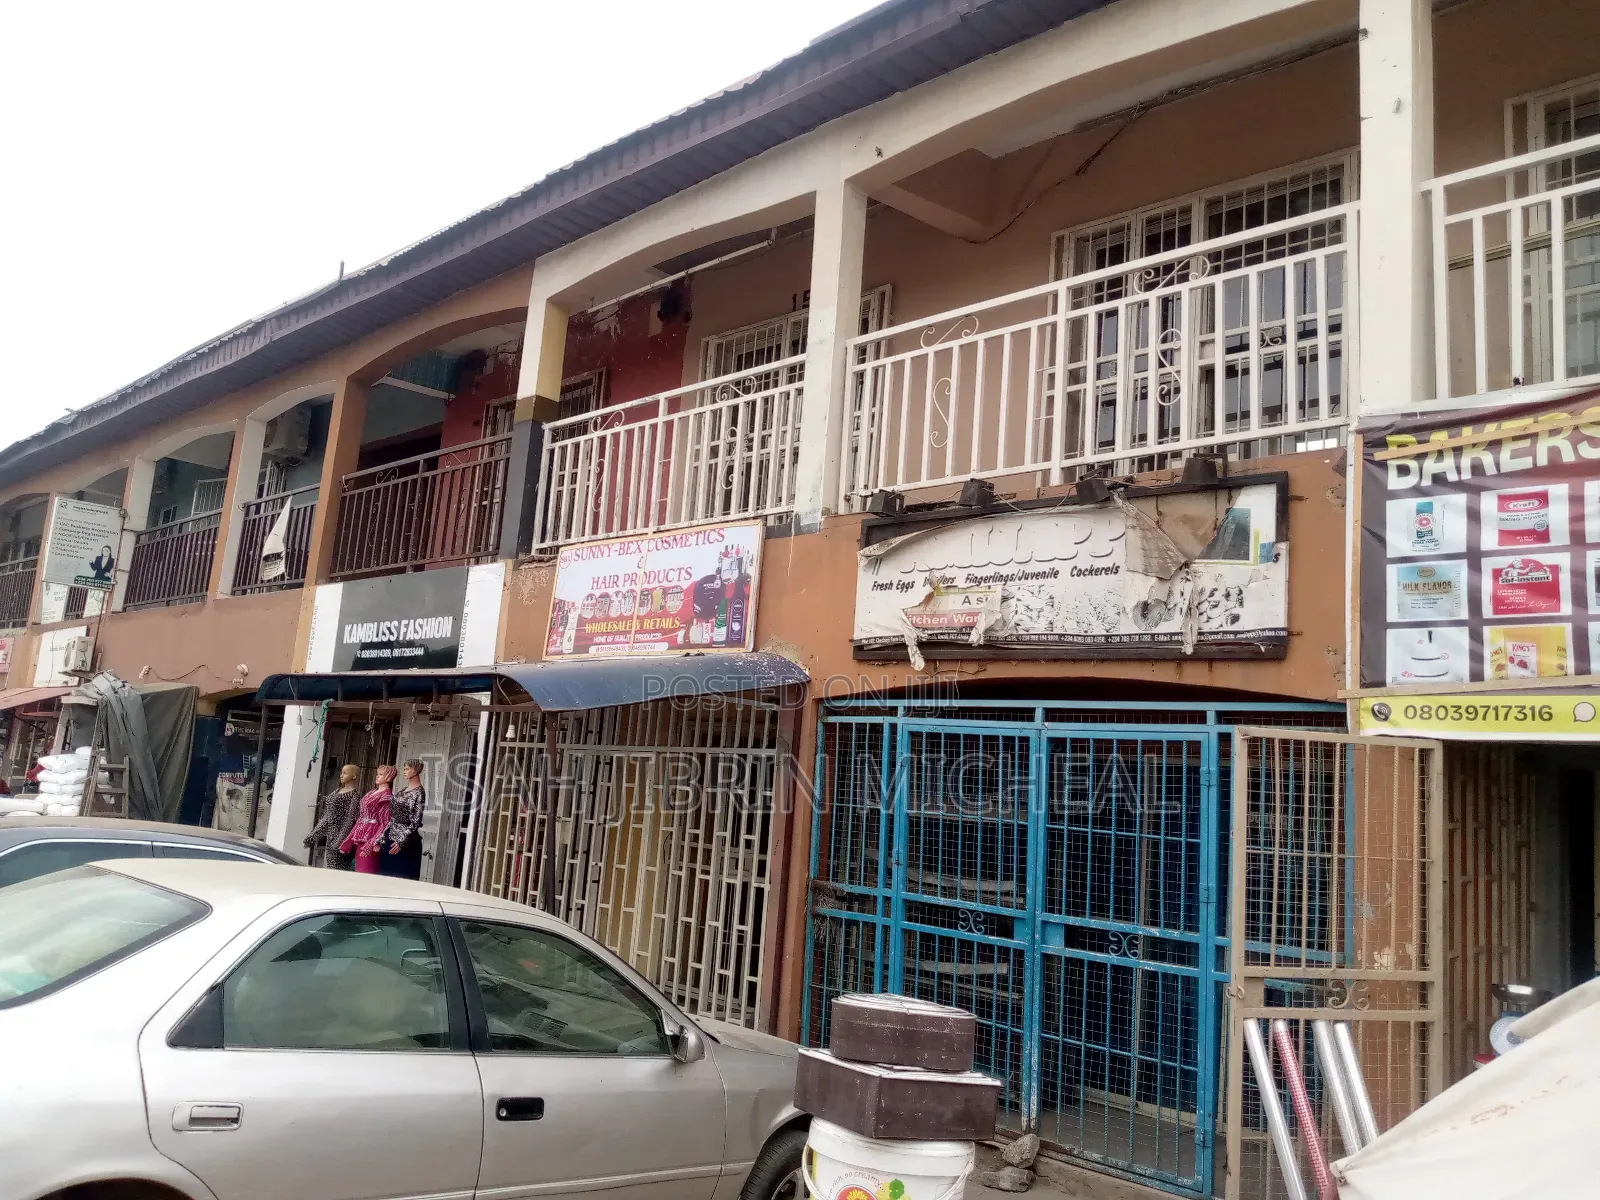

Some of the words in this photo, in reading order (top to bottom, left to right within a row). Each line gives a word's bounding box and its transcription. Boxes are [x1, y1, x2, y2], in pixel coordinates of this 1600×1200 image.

[573, 540, 644, 562] SUNNY-BEX
[647, 528, 726, 552] COSMETICS
[591, 574, 619, 591] HAIR
[622, 567, 693, 588] PRODUCTS
[872, 580, 893, 591] Fresh
[895, 579, 915, 593] Eggs
[1070, 562, 1120, 578] Cockerels
[1500, 575, 1551, 584] saf-instant
[1402, 582, 1420, 592] MILK
[1422, 581, 1452, 591] FLAVOR
[961, 595, 972, 606] A
[585, 620, 634, 634] WHOLESALE
[643, 617, 681, 630] RETAILS
[905, 614, 948, 625] itchen
[343, 620, 399, 644] KAMBLISS
[400, 616, 453, 640] FASHION
[594, 635, 606, 643] HOME
[1403, 704, 1554, 722] 08039717316
